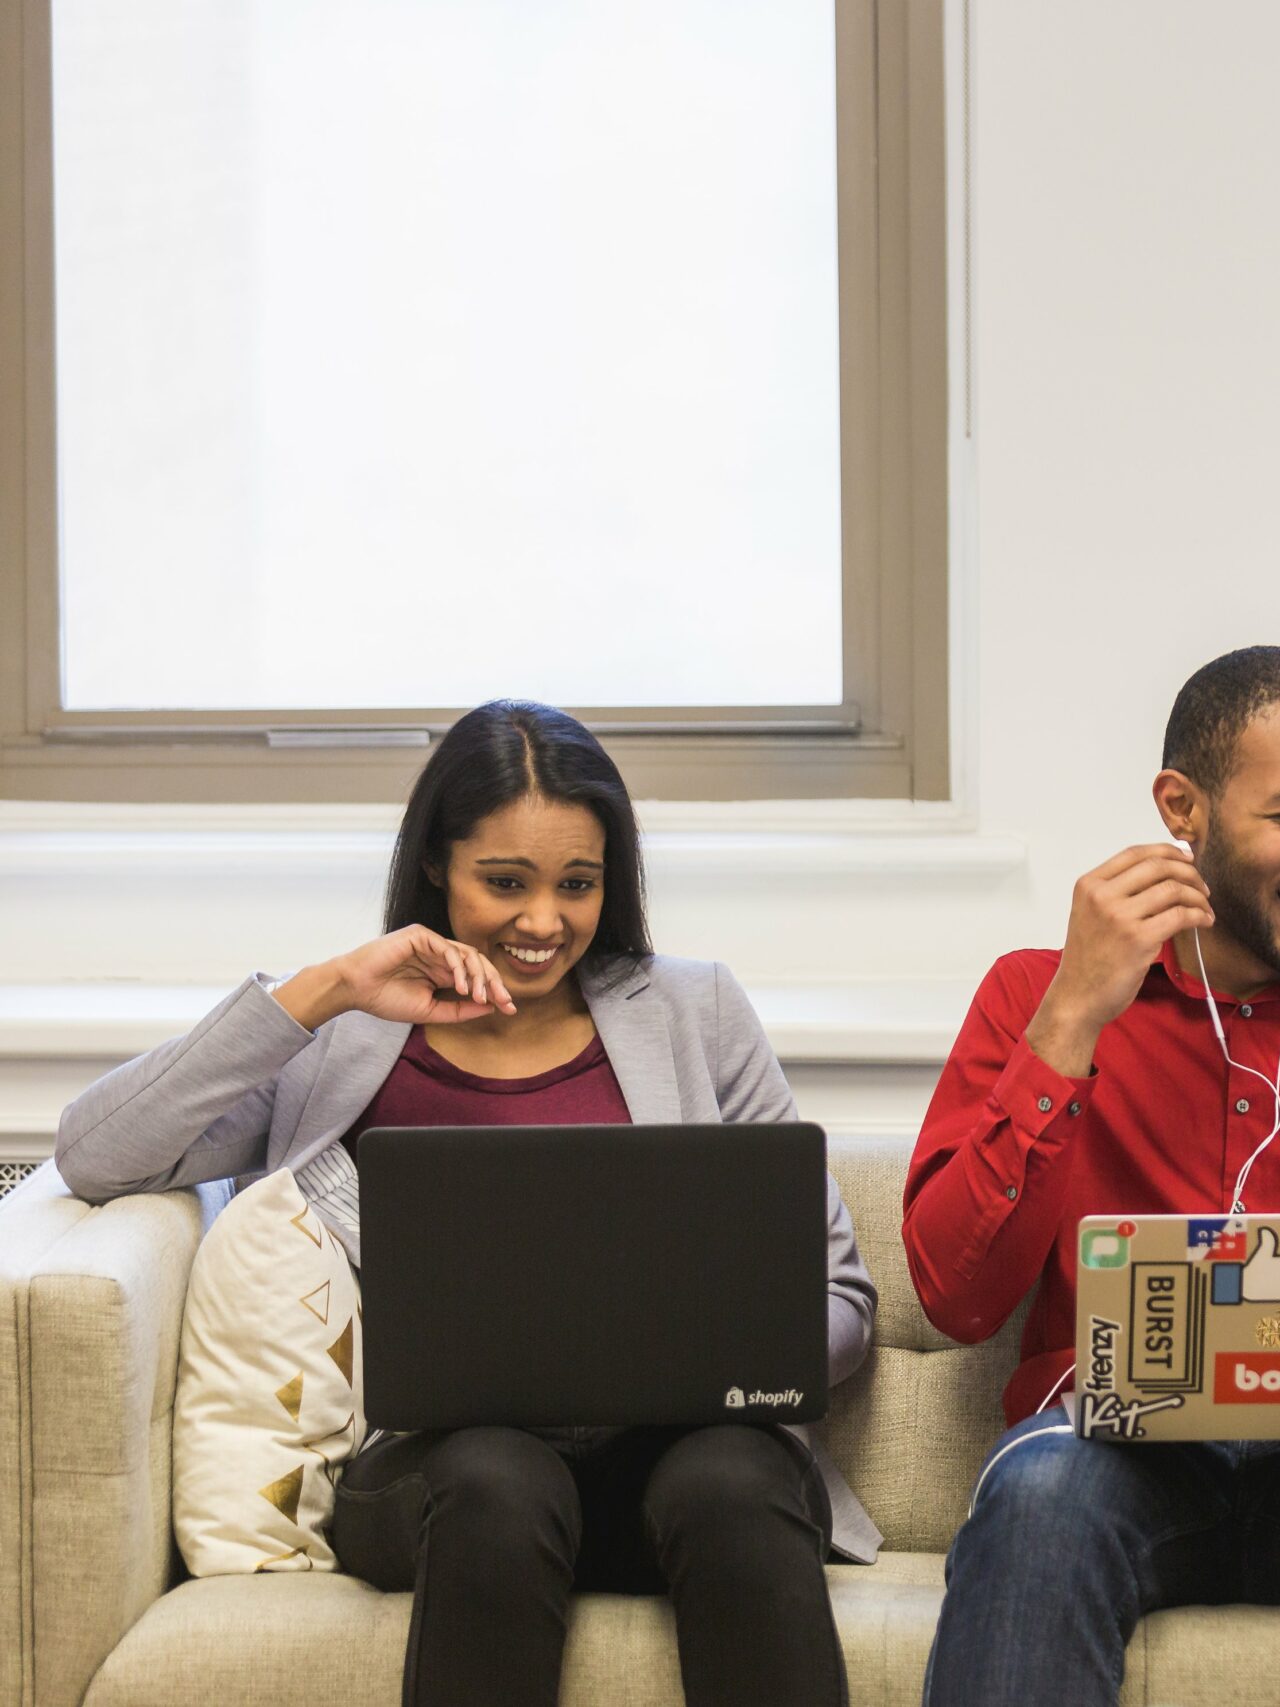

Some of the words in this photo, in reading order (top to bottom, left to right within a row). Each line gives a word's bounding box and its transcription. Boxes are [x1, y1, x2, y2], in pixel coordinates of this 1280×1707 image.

[1087, 1317, 1120, 1391] frenzy
[1144, 1276, 1175, 1369] BURST
[748, 1388, 804, 1407] shopify
